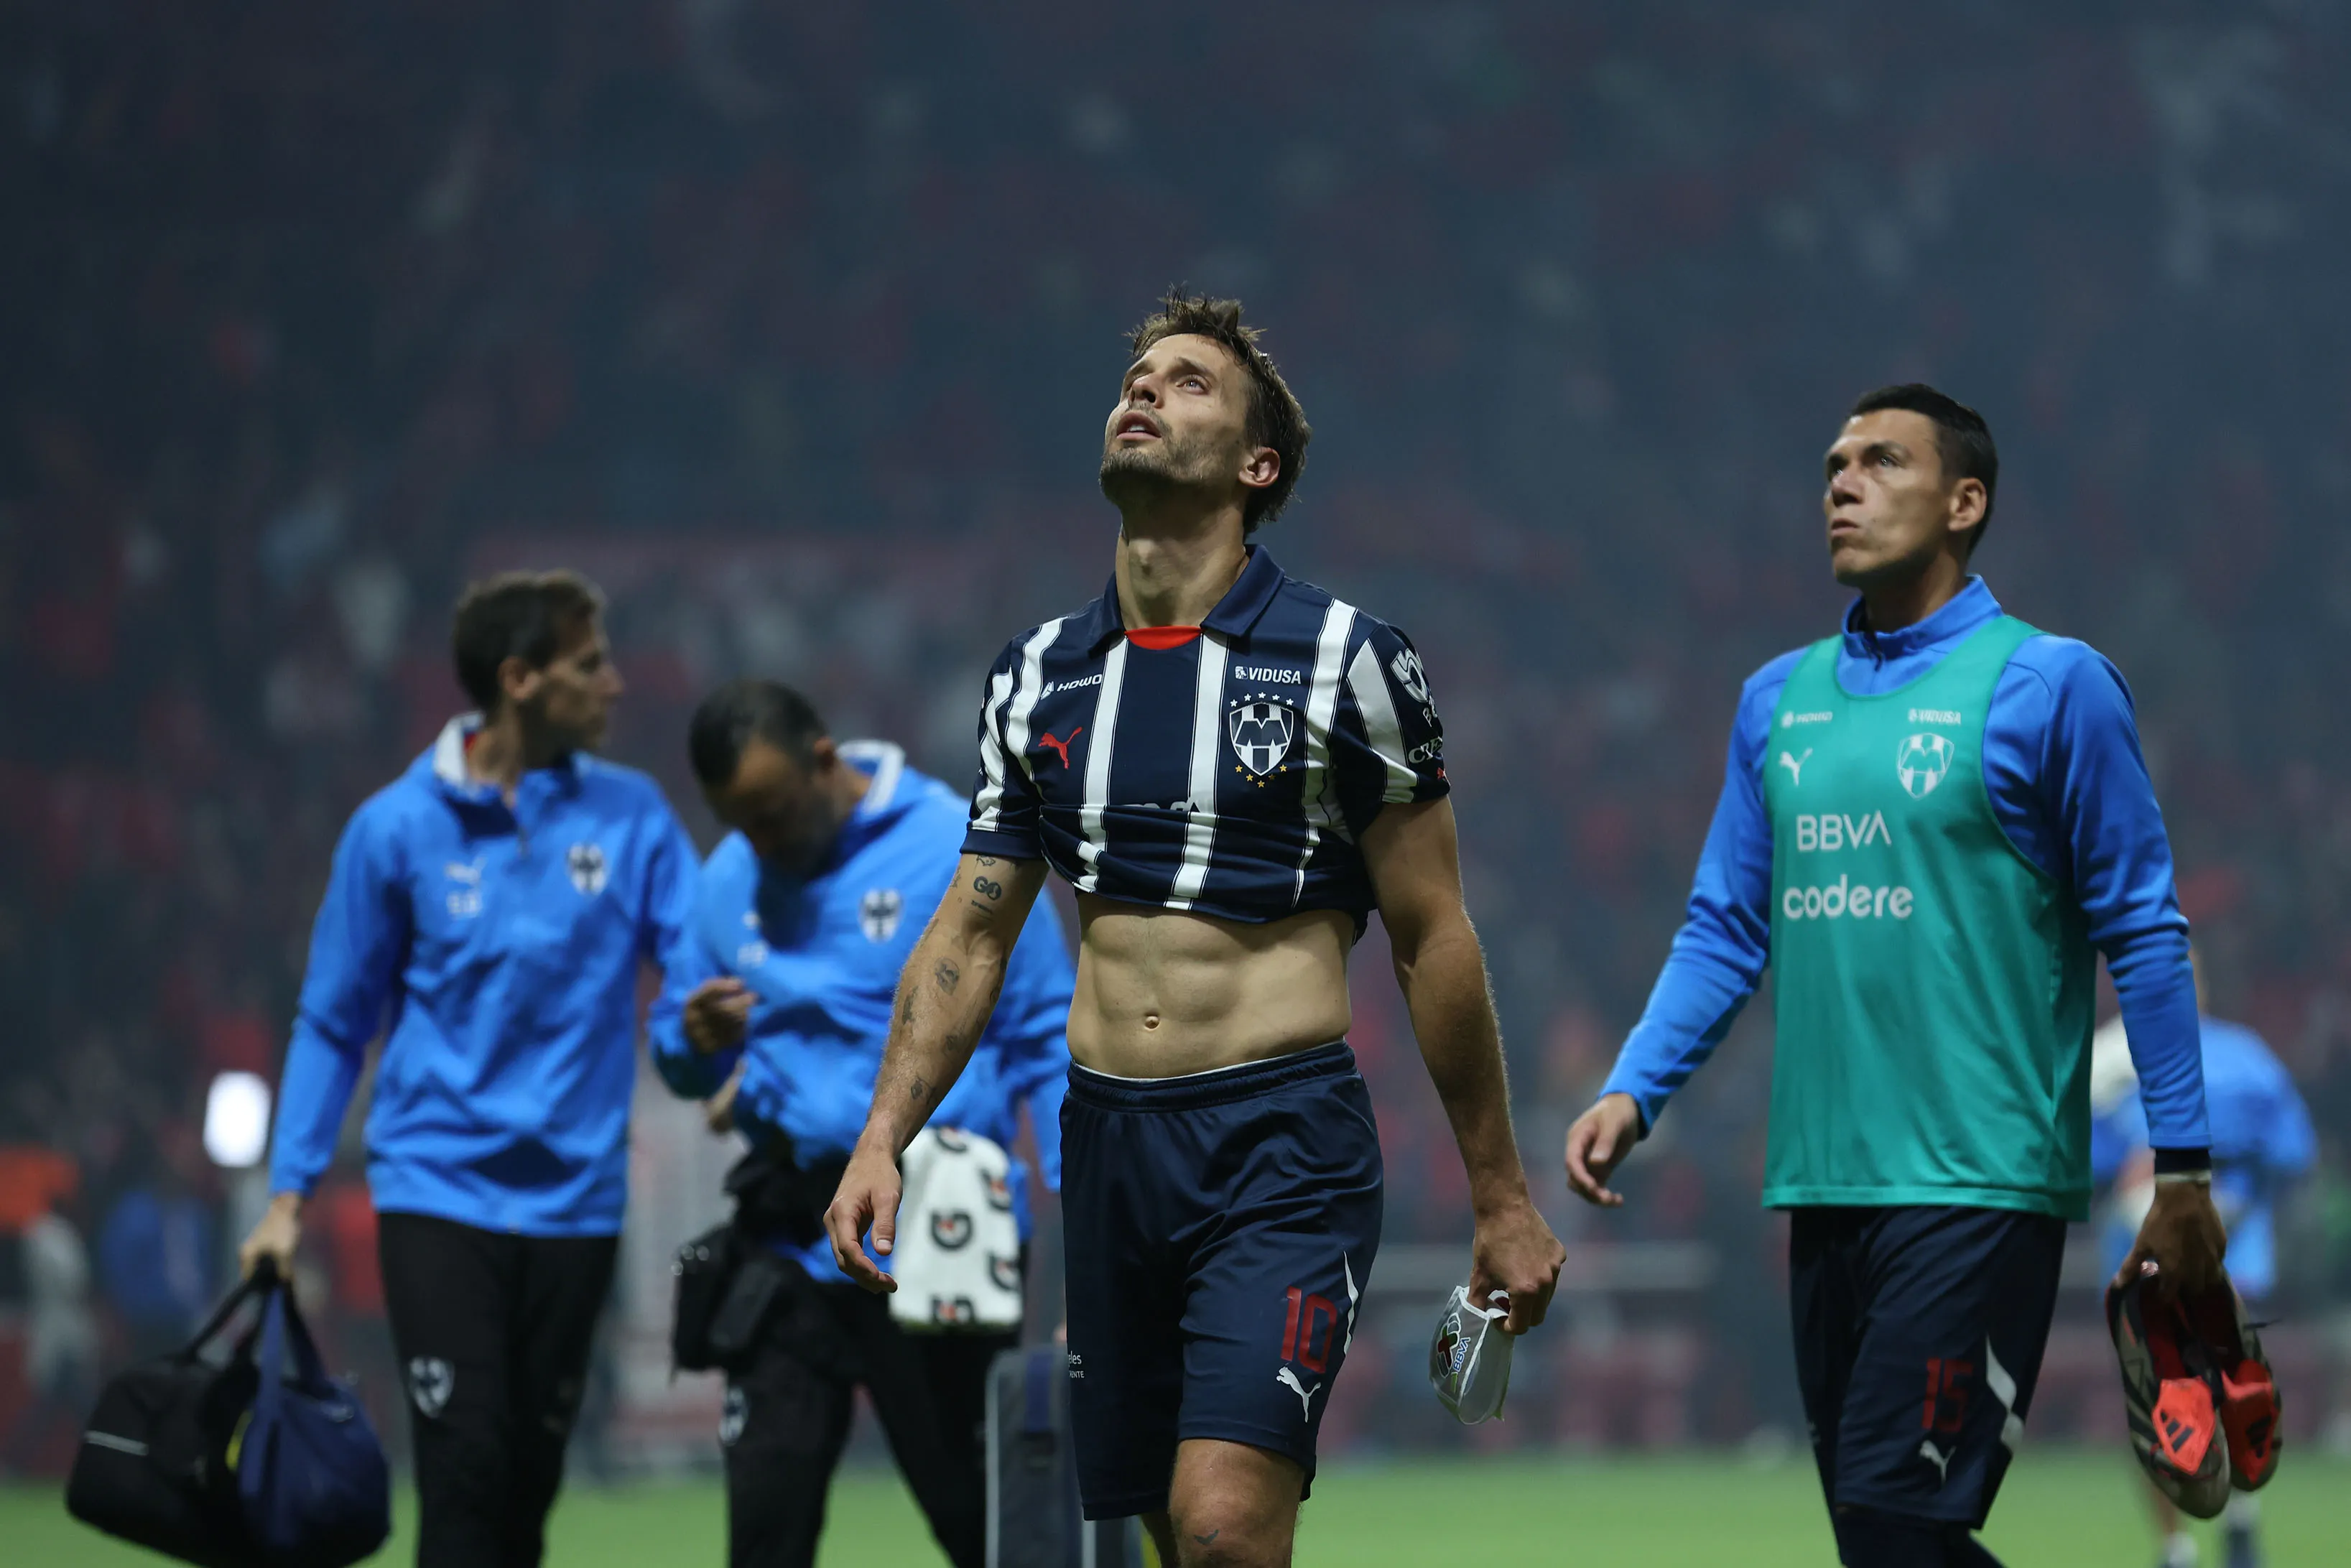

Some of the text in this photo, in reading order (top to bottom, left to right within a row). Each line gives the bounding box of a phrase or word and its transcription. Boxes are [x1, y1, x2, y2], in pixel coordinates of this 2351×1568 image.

[1057, 674, 1103, 692] HOWO
[1249, 667, 1302, 685] VIDUSA
[1796, 809, 1891, 852] BBVA
[1783, 873, 1914, 919] codere
[1281, 1286, 1337, 1373] 10
[1452, 1337, 1471, 1373] BBVA
[1921, 1358, 1973, 1432] 15
